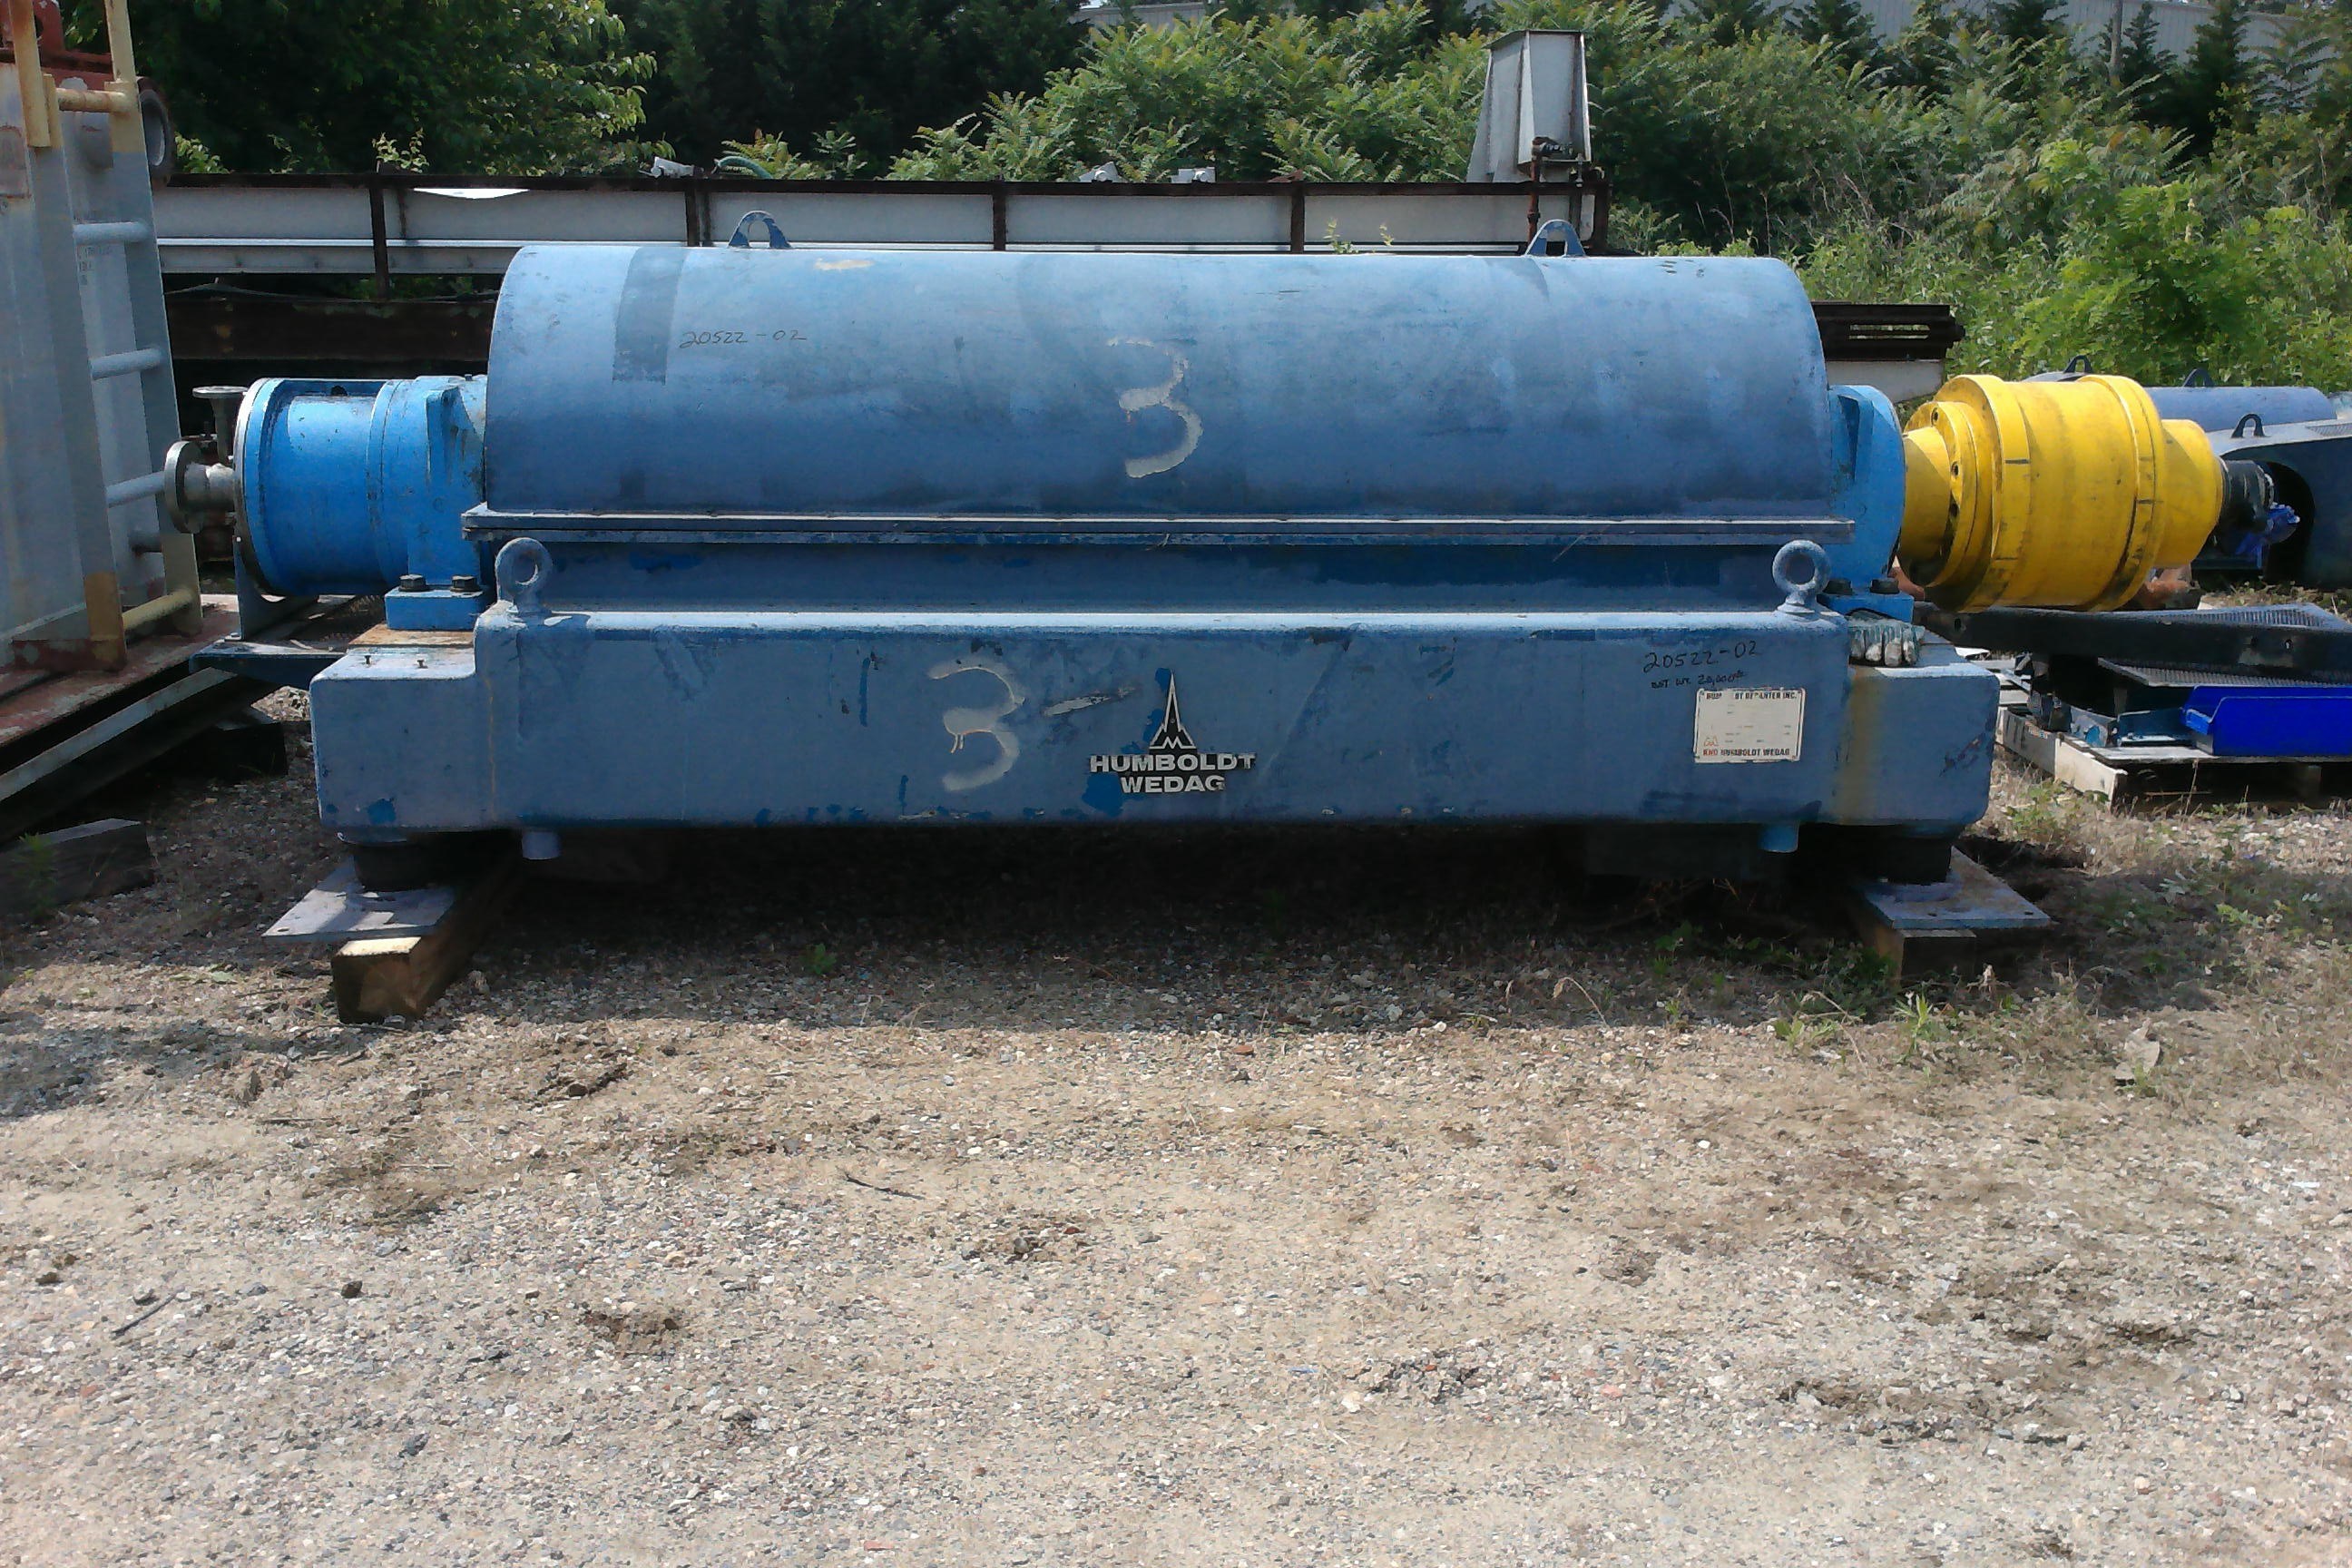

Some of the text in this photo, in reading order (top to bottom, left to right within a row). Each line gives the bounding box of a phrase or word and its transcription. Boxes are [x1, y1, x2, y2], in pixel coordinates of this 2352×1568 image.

[1106, 336, 1204, 478] 3
[927, 657, 1024, 792] 3
[1090, 752, 1256, 773] HUMBOLDT
[1121, 775, 1225, 793] WEDAG
